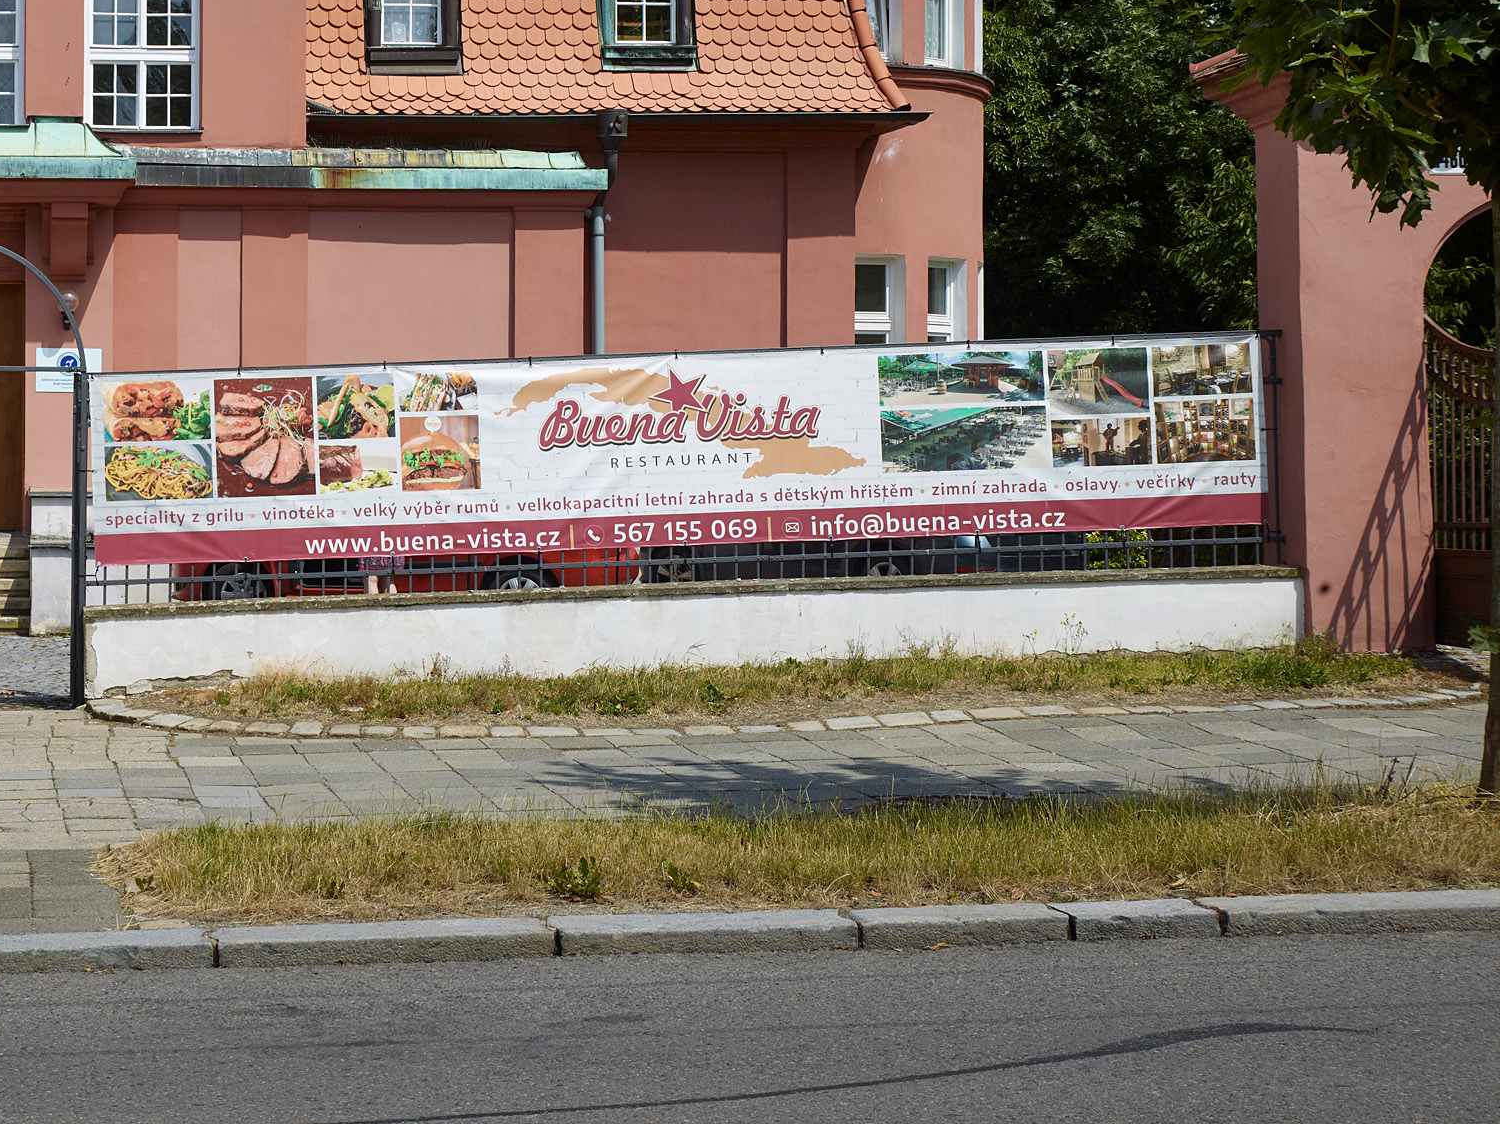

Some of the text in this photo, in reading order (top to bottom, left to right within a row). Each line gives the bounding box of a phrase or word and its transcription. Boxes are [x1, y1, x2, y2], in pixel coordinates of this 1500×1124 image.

[539, 392, 821, 450] Buena Vista
[610, 452, 753, 469] RESTAURANT
[106, 472, 1256, 529] speciality z grilu vinotéka velký výběr rumů velkokapacitní letní zahrada s dětským hřištěm zimní zahrada oslavy večírky rauty
[305, 508, 1066, 555] www.buena-vista.cz 567 155 069 info@buena-vista.cz
